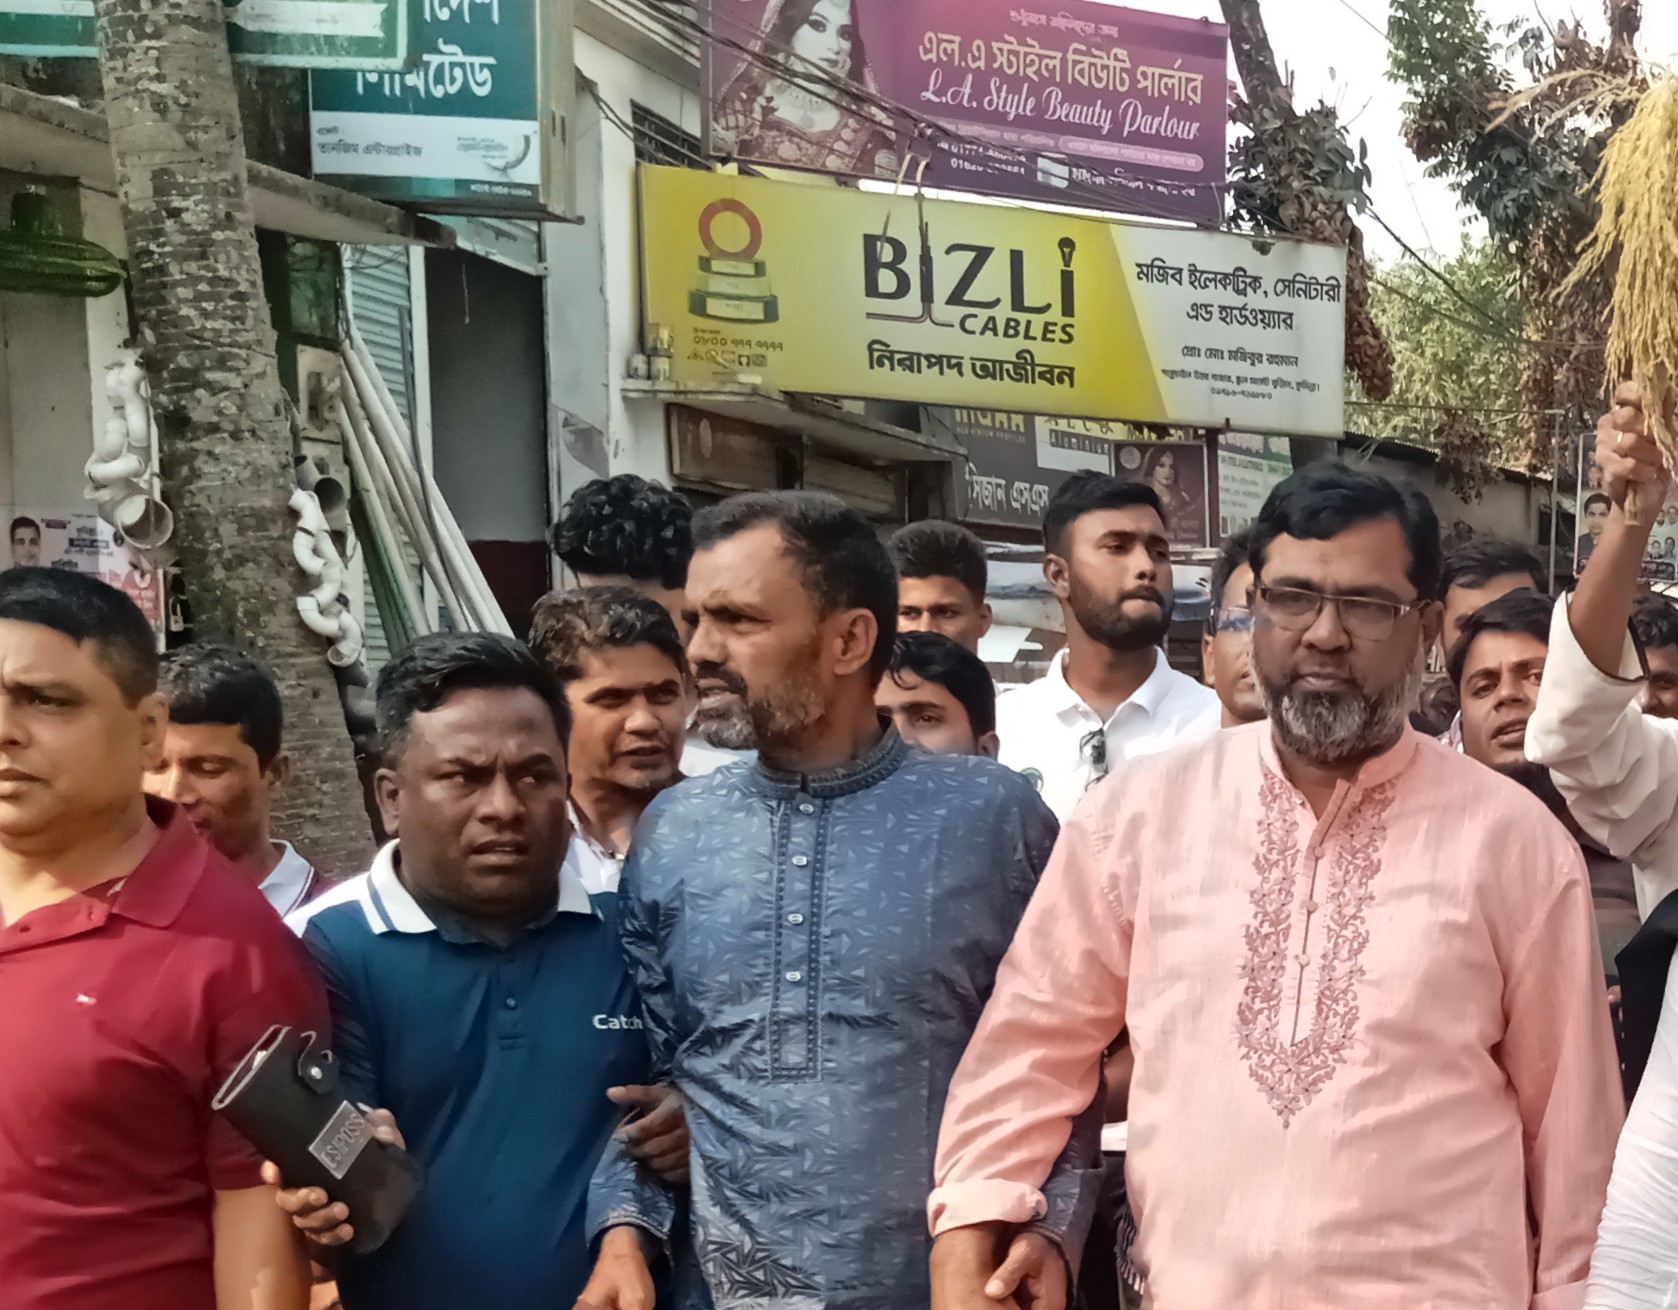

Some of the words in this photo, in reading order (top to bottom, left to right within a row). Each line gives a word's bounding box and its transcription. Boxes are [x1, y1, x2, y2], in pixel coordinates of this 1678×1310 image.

[991, 34, 1063, 83] স্টাইল
[1067, 43, 1131, 93] বিউটি
[1136, 58, 1204, 108] পার্লার
[920, 68, 977, 108] L.A.
[983, 76, 1036, 121] Style
[1042, 86, 1114, 135] Beauty
[1118, 99, 1200, 141] Parlour
[1135, 257, 1183, 287] মজিব
[1274, 273, 1341, 302] সেনিটারী
[959, 312, 1076, 345] CABLES
[867, 339, 963, 377] নিরাপদ
[970, 349, 1076, 388] আজীবন
[1266, 353, 1298, 367] রহমান
